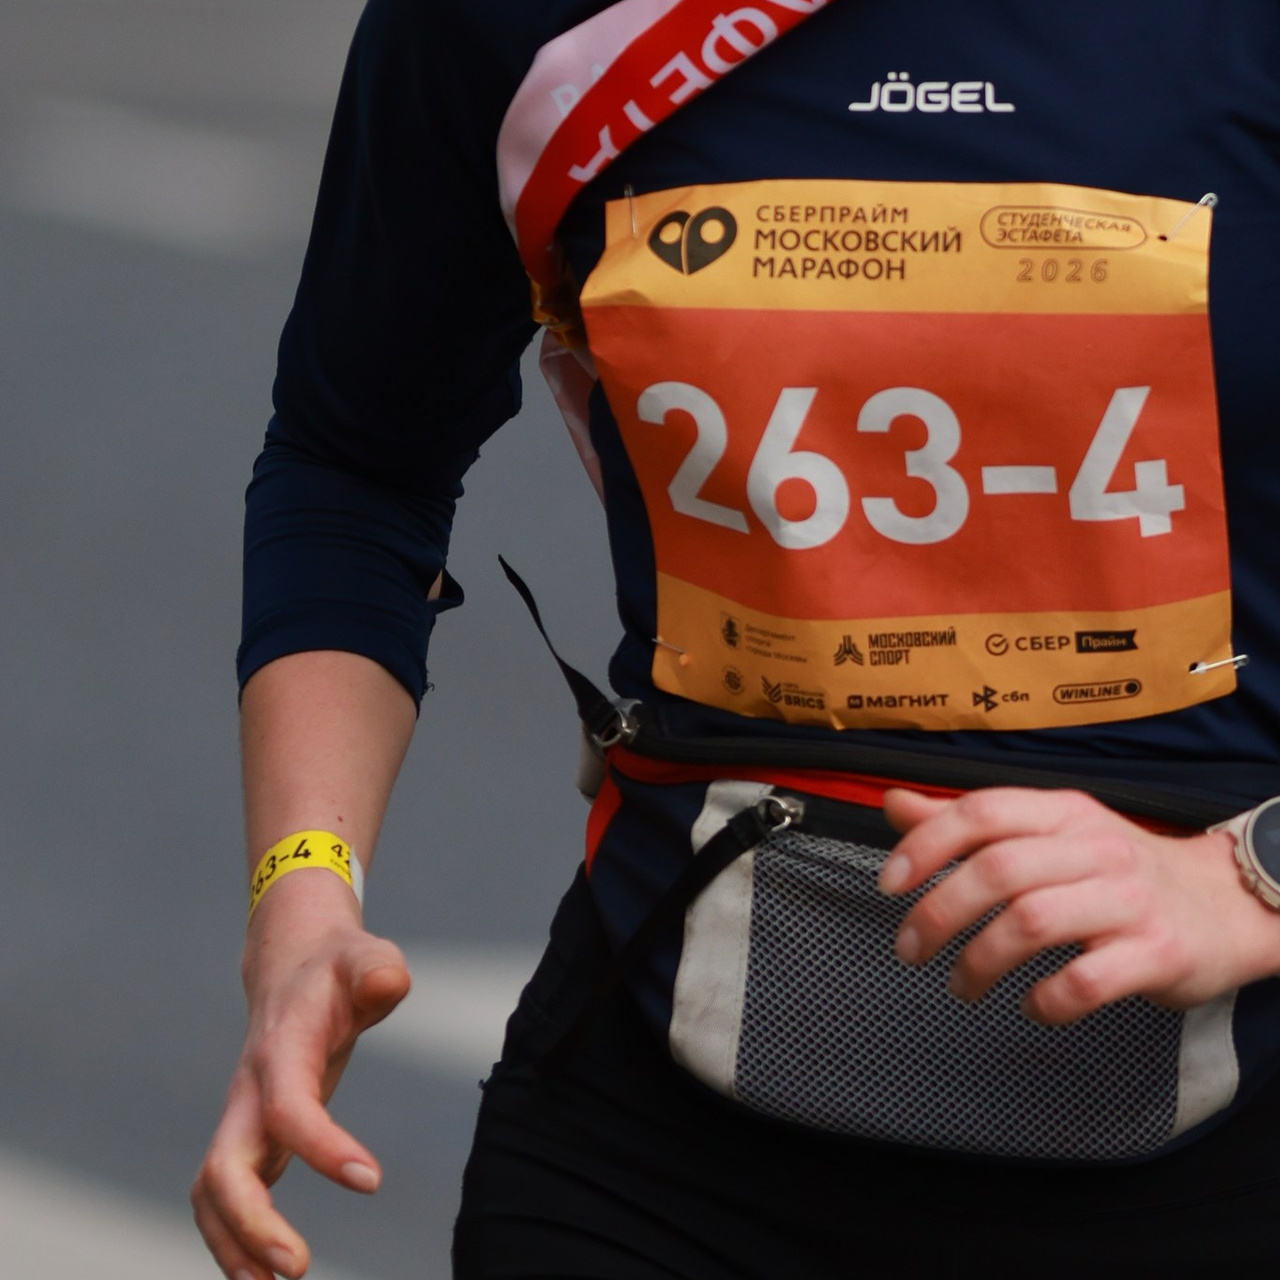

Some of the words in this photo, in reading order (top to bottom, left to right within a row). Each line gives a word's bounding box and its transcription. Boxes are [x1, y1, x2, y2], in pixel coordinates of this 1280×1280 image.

[848, 71, 1015, 113] JÖGEL
[756, 203, 909, 223] СБЕРПРАЙМ
[996, 212, 1132, 234] СТУДЕНЧЕСКАЯ
[753, 225, 962, 254] МОСКОВСКИЙ
[996, 227, 1084, 244] ЭСТАФЕТА
[752, 256, 906, 281] МАРАФОН
[1016, 257, 1111, 284] 2026
[636, 380, 1186, 550] 263-4
[869, 626, 956, 649] МОСКОВСКИЙ
[1015, 635, 1070, 651] СБЕР
[1081, 635, 1127, 649] Прайм
[869, 649, 911, 666] СПОРТ
[1002, 691, 1030, 703] сбп
[1060, 683, 1122, 700] WINLINE
[783, 694, 825, 711] BRICS
